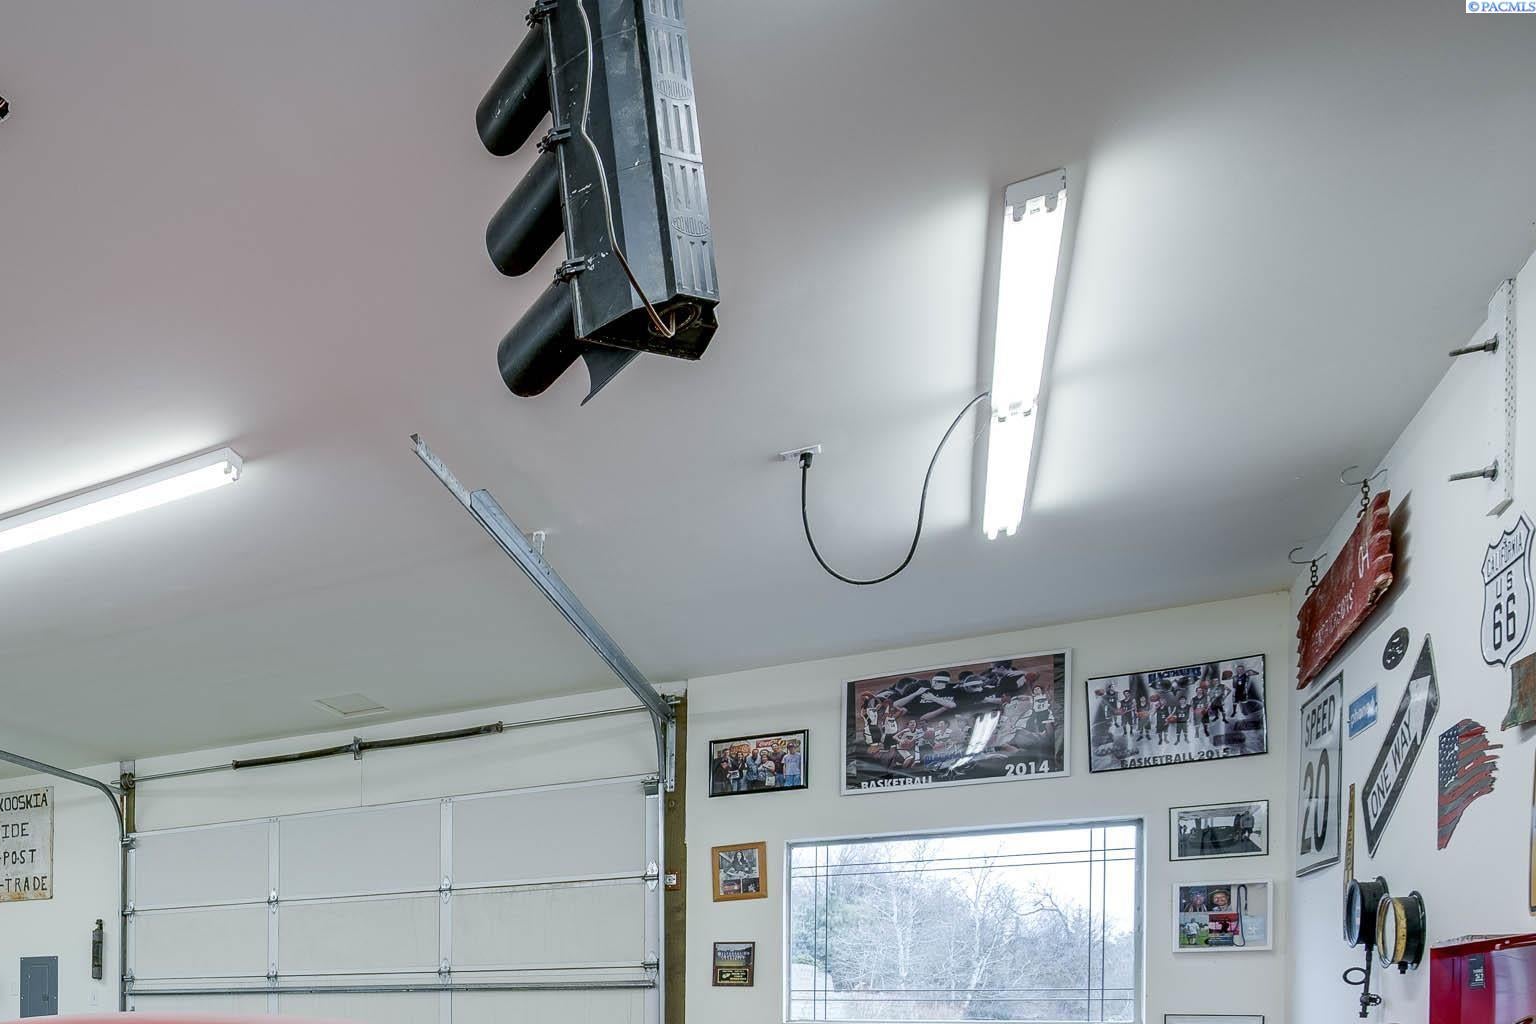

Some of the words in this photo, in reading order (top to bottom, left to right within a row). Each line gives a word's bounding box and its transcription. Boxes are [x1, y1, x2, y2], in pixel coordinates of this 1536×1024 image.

[1487, 532, 1523, 577] CALIFORNIA
[1493, 592, 1516, 652] 66
[1304, 694, 1335, 748] SPEED
[861, 775, 933, 790] BASKETBALL
[1005, 760, 1050, 776] 2014
[1120, 750, 1194, 768] BASKETBALL
[1198, 747, 1229, 760] 2015
[1371, 762, 1392, 819] ONE
[1391, 713, 1414, 772] WAY
[1300, 748, 1330, 855] 20
